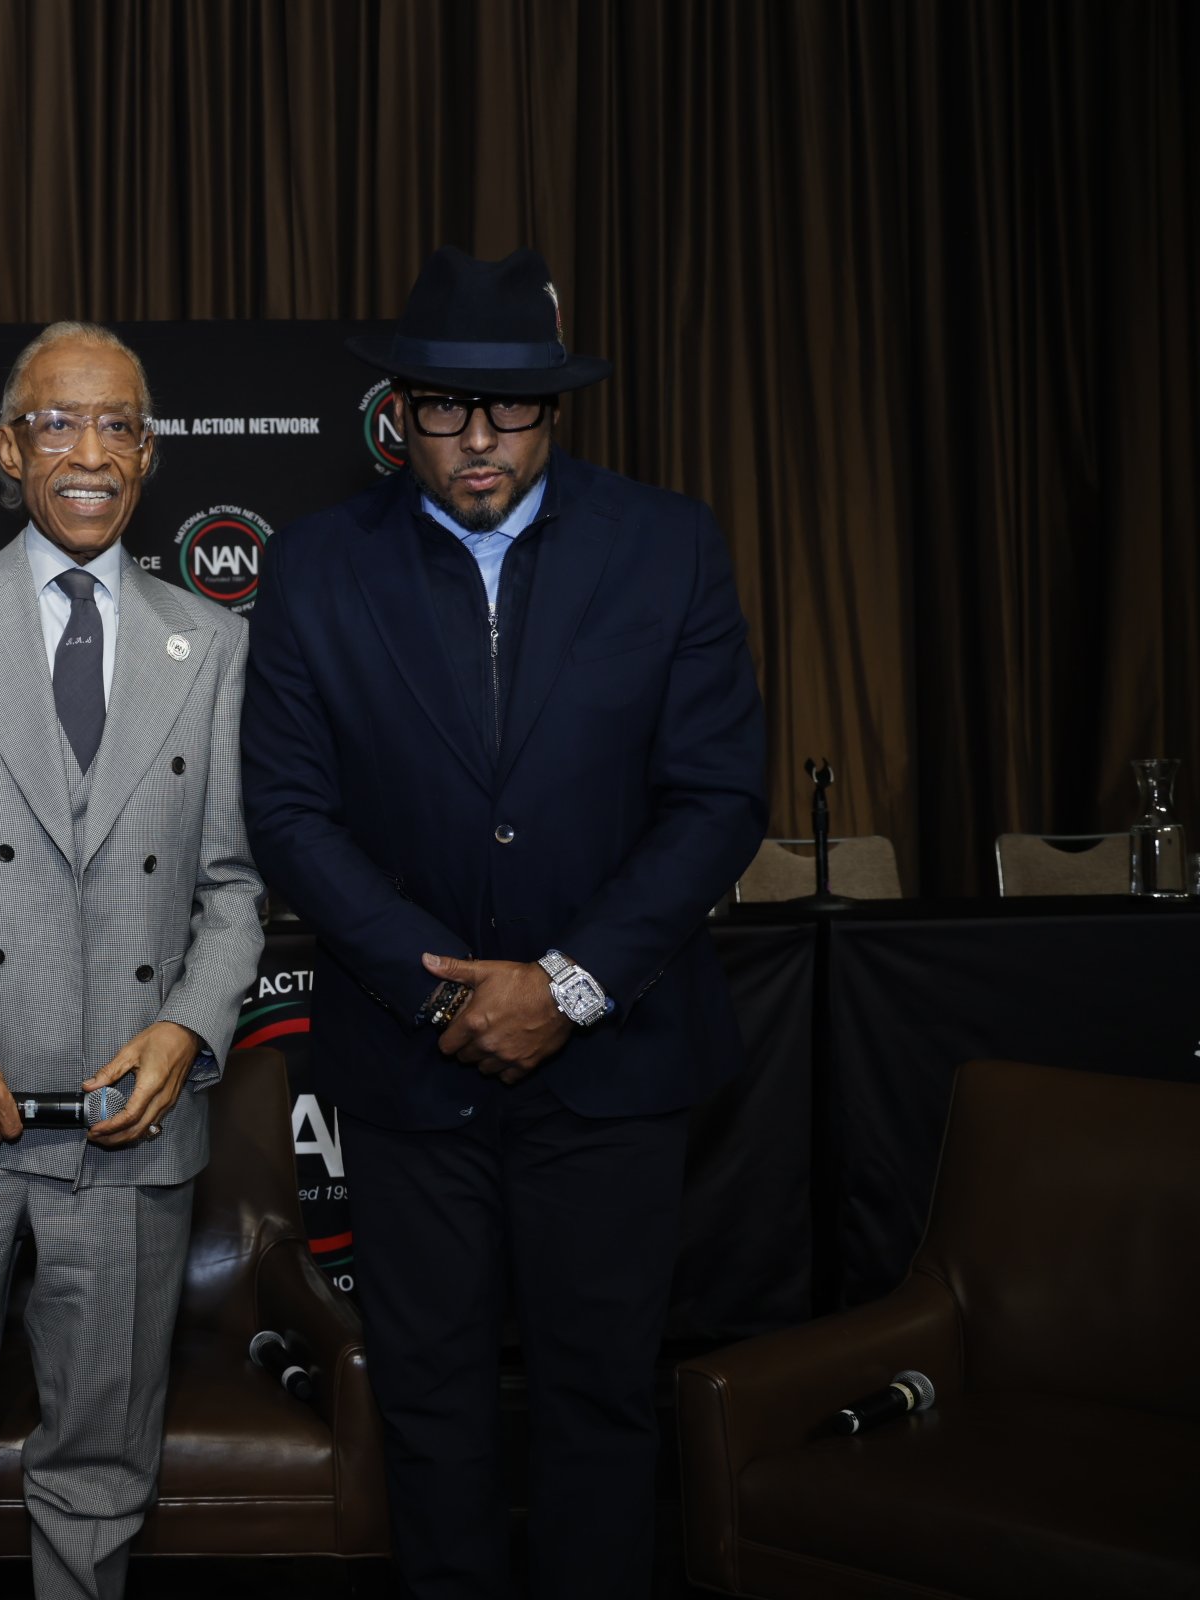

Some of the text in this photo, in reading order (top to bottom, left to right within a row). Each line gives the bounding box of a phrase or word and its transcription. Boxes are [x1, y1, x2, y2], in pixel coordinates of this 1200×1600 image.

[191, 417, 245, 435] ACTION
[249, 417, 321, 435] NETWORK
[173, 510, 208, 544] NATIONAL
[209, 505, 242, 515] ACTION
[132, 556, 161, 570] CE
[193, 545, 258, 576] NAN
